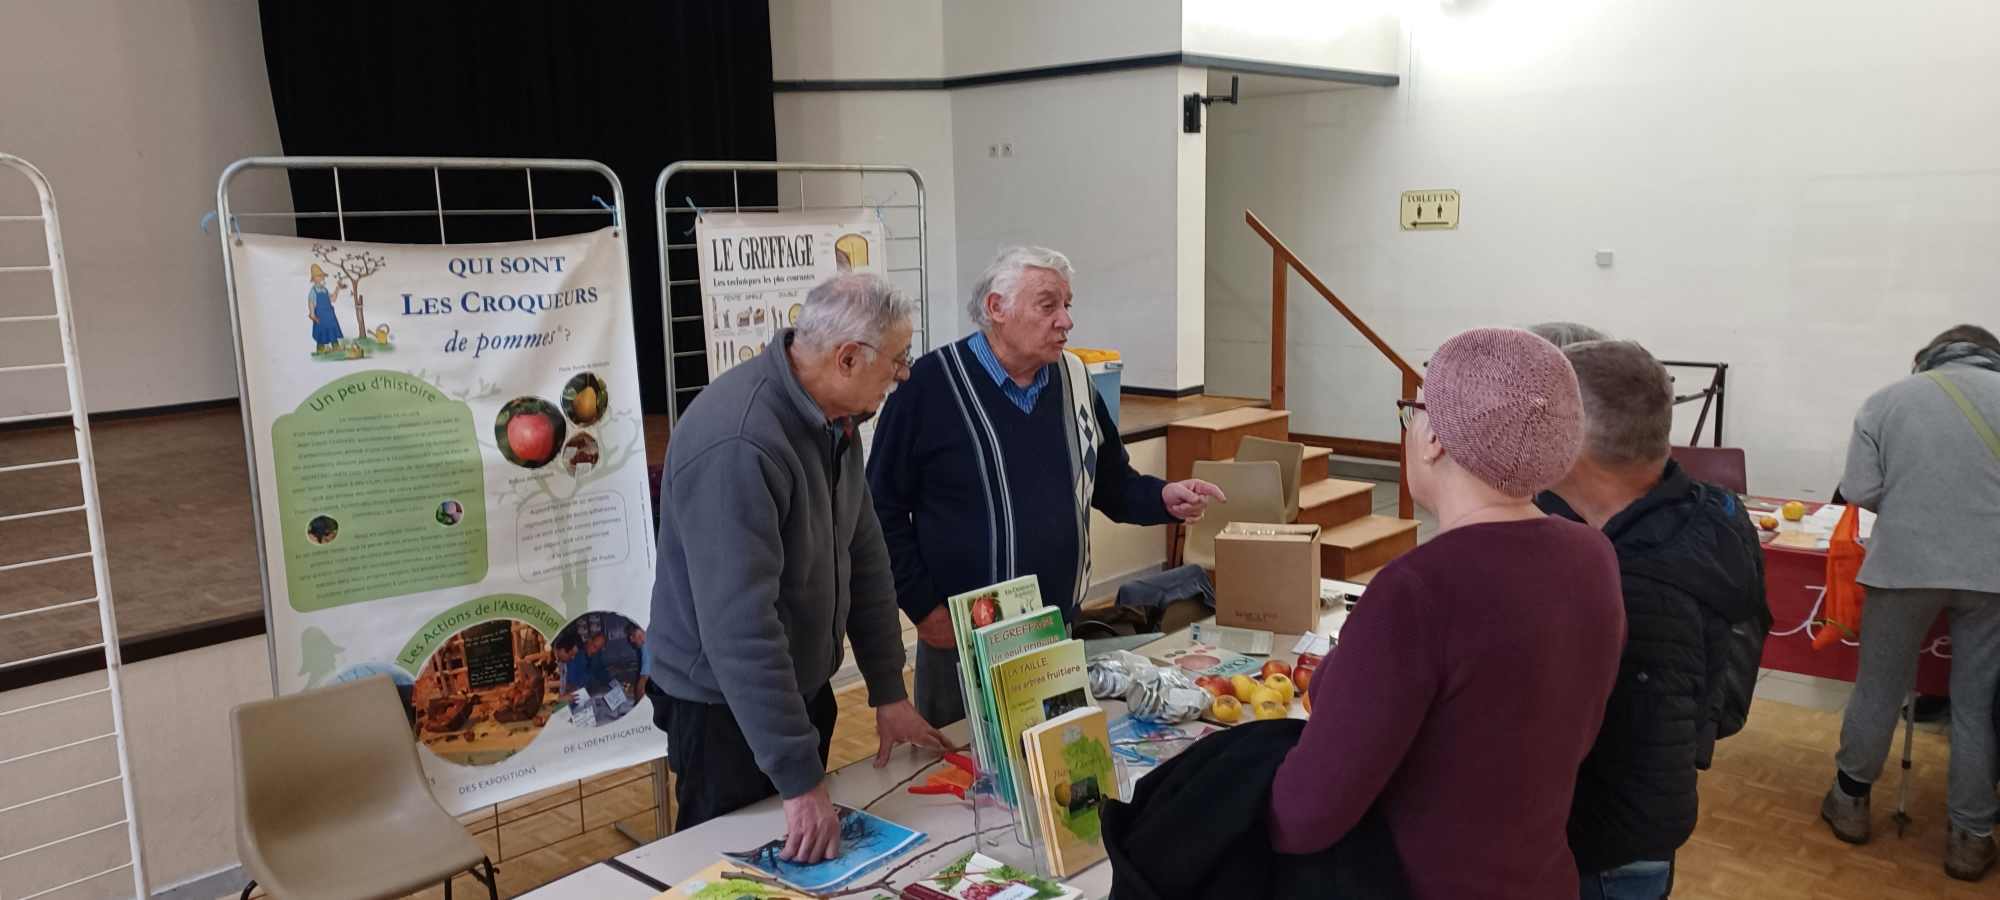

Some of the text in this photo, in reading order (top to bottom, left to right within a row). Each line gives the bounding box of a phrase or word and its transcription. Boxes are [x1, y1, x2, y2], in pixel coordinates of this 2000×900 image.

[1407, 193, 1455, 203] TOILETTES
[712, 238, 734, 272] LE
[738, 234, 815, 270] GREFFAGE
[448, 256, 566, 278] QUI SONT
[401, 286, 598, 315] LES CROQUEURS
[444, 330, 468, 353] de
[309, 376, 436, 412] Un peu d'histoire
[403, 600, 560, 665] Les Actions de l'Association
[1020, 656, 1049, 673] TAILLE
[563, 744, 575, 755] DE
[458, 766, 537, 795] DES EXPOSITIONS
